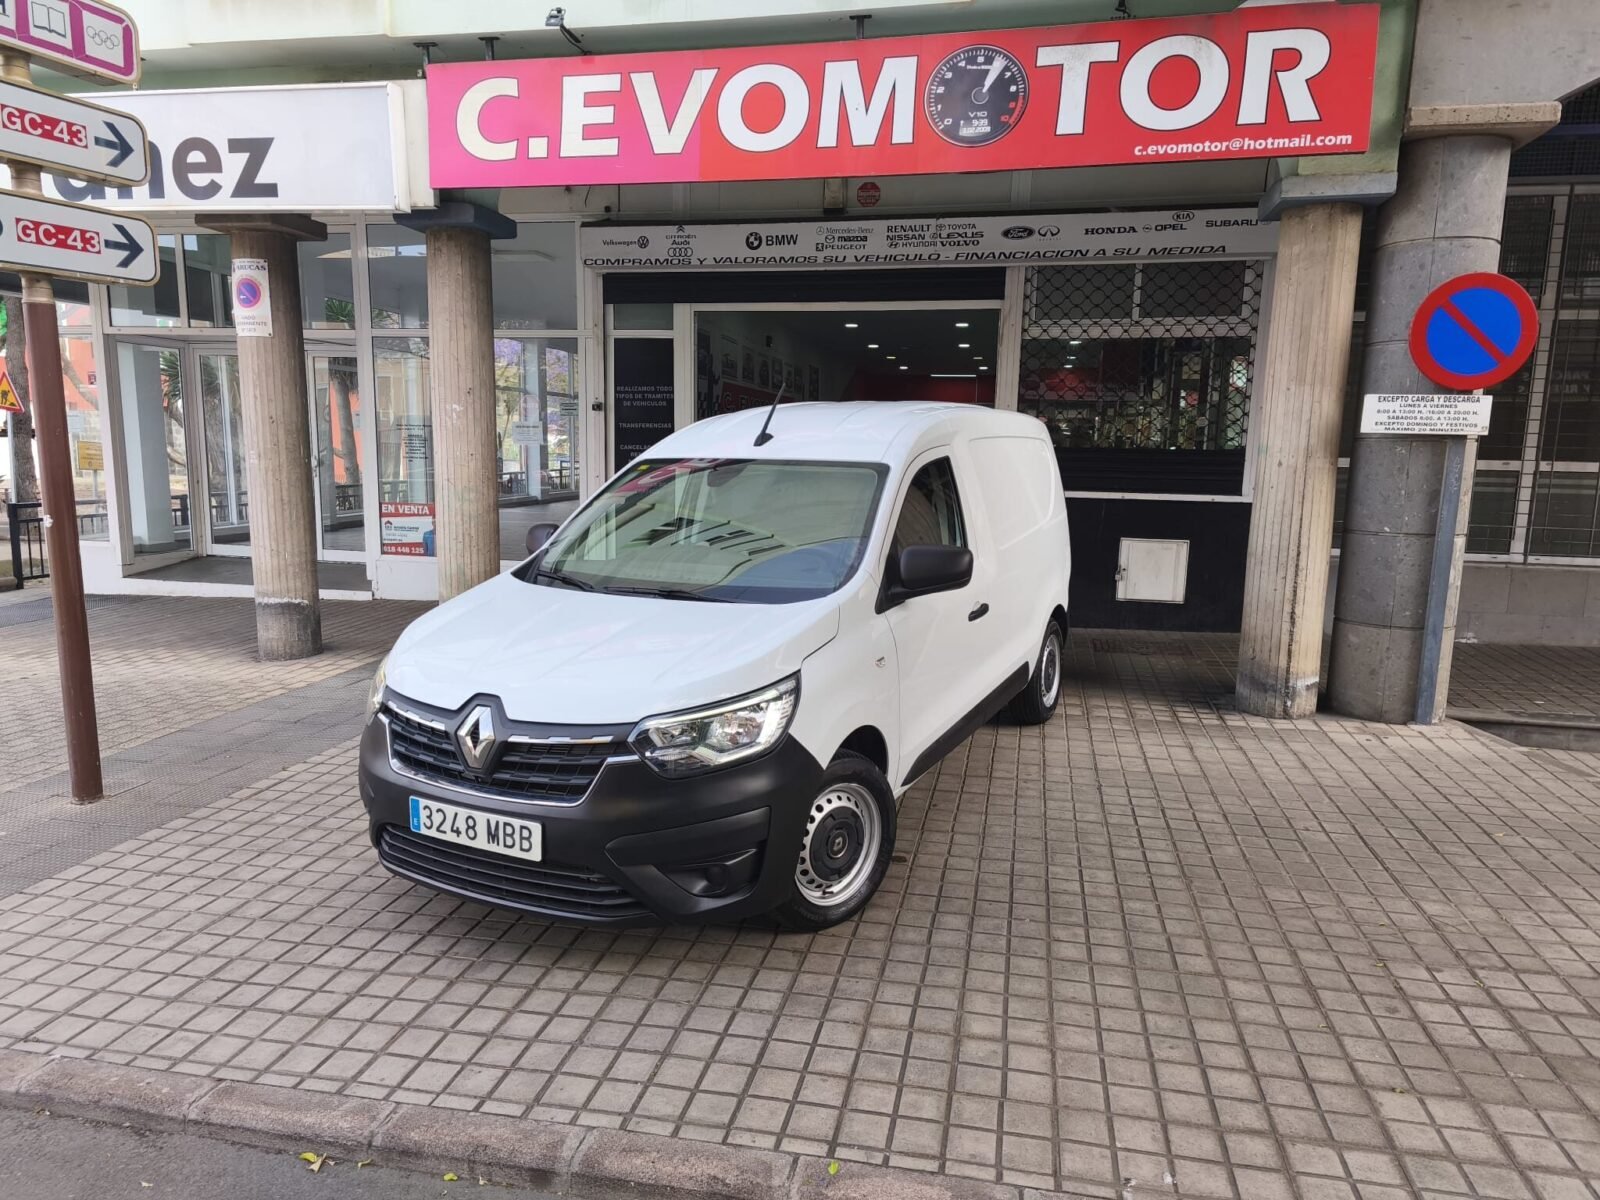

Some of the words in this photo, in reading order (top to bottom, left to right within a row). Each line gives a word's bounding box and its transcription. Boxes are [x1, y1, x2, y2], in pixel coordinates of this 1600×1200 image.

[2, 107, 87, 148] GC-43
[1134, 133, 1353, 156] c.evomotor@hotmail.com
[1175, 212, 1192, 220] KIA
[886, 223, 932, 233] RENAULT
[1154, 223, 1187, 232] OPEL
[1205, 218, 1258, 228] SUBARU
[938, 231, 984, 239] LEXUS
[1084, 226, 1138, 236] HONDA
[17, 220, 100, 253] GC-43
[765, 234, 799, 247] BMW
[886, 233, 926, 241] NISSAN
[602, 239, 637, 247] Volkswagen
[939, 239, 980, 247] VOLVO
[583, 257, 692, 266] COMPRAMOS
[697, 257, 707, 265] Y
[712, 255, 818, 265] VALORAMOS
[822, 255, 847, 263] SU
[854, 252, 941, 262] VEHICULO
[954, 248, 1089, 261] FINANCIACION
[1092, 247, 1107, 257] A
[1112, 247, 1141, 256] SU
[1147, 245, 1227, 256] MEDIDA
[1378, 395, 1410, 403] EXCEPTO
[1411, 395, 1435, 403] CARGA
[1443, 395, 1481, 404] DESCARGA
[381, 504, 395, 513] EN
[397, 504, 430, 514] VENTA
[422, 805, 478, 841] 3248
[486, 818, 533, 853] MBB
